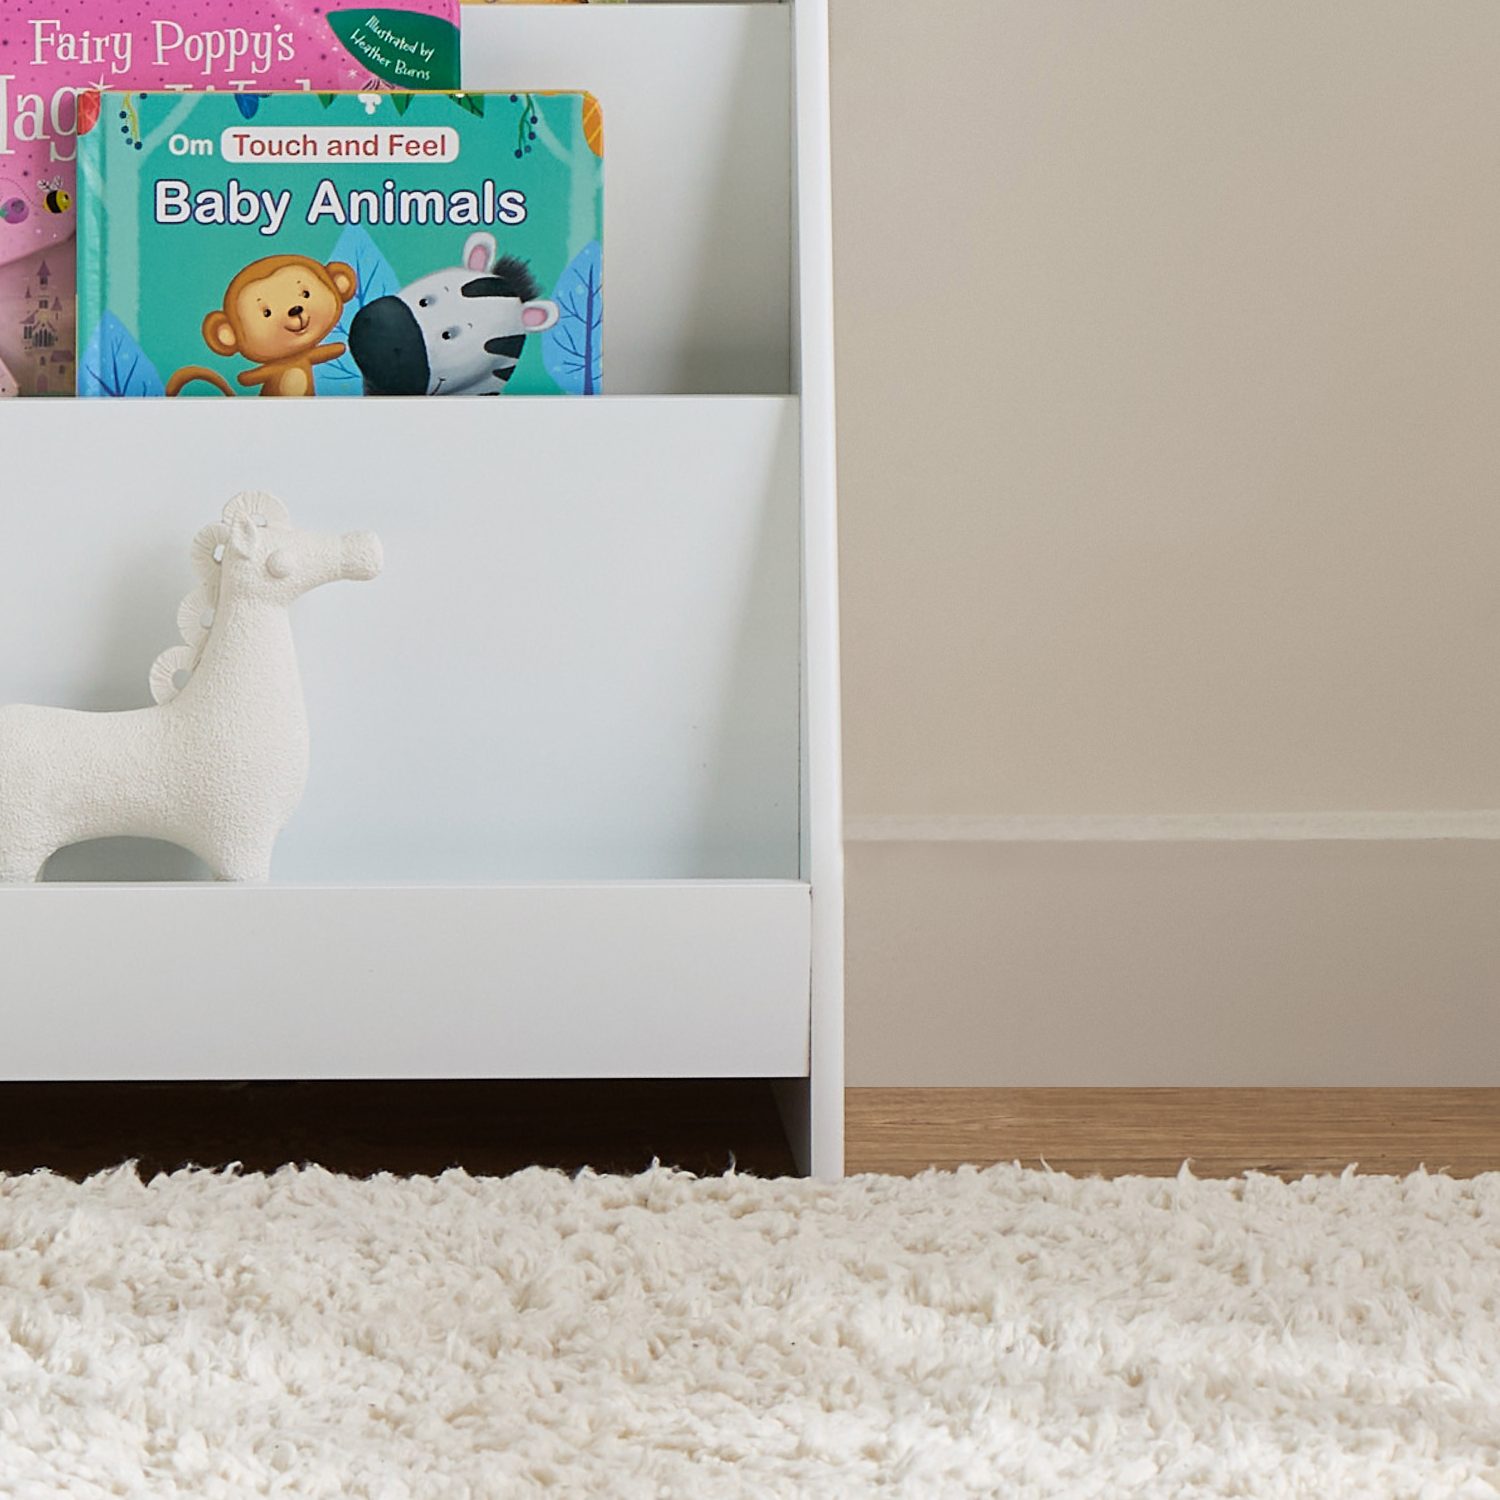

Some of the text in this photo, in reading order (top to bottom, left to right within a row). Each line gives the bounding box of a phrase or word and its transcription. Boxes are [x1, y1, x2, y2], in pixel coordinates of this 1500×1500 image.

[28, 19, 295, 75] Fairy Poppy's
[350, 28, 430, 80] Heather Burns
[365, 15, 434, 62] Illustrated by
[168, 133, 446, 157] Om Touch and Feel
[154, 178, 529, 235] Baby Animals
